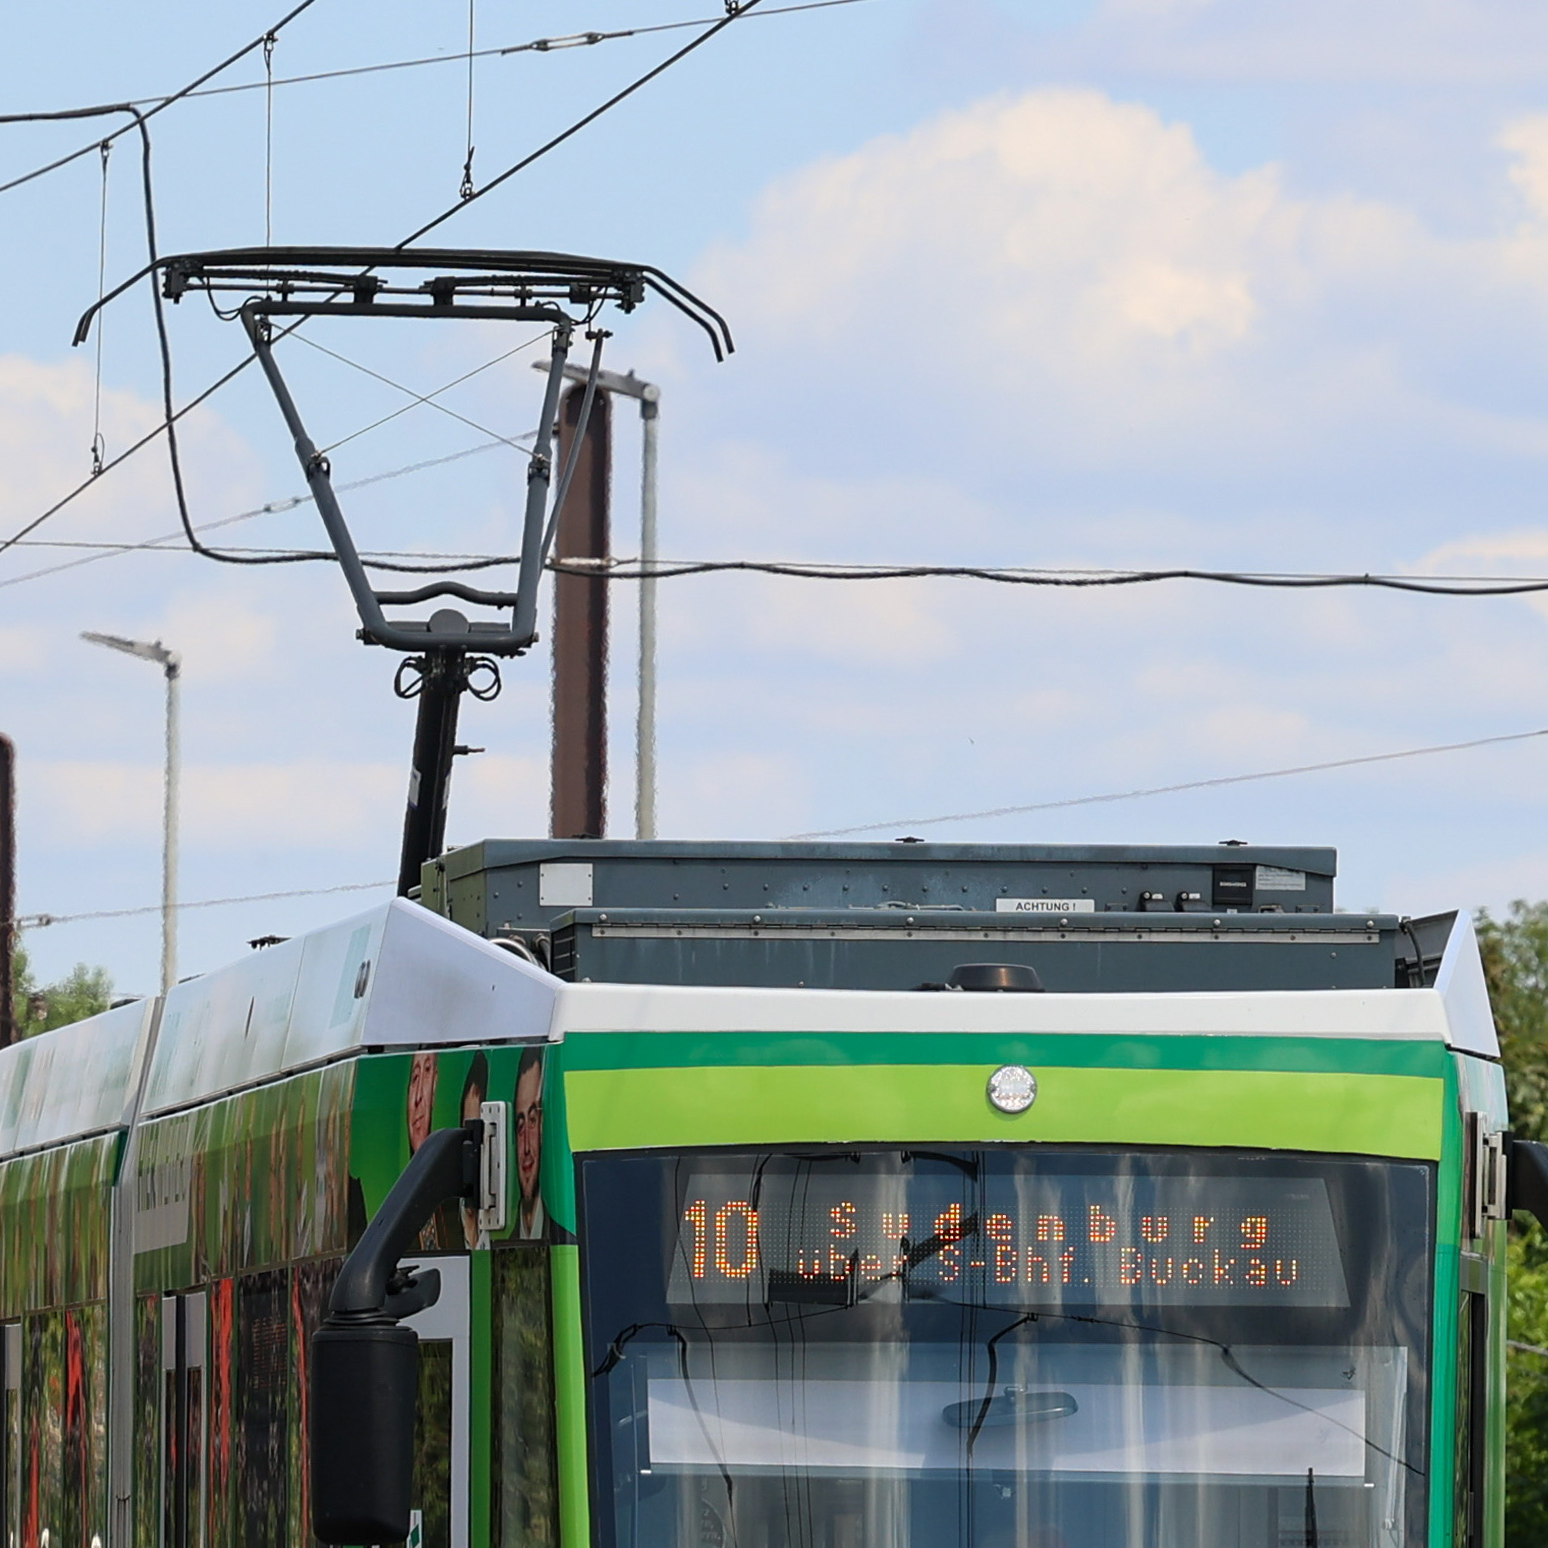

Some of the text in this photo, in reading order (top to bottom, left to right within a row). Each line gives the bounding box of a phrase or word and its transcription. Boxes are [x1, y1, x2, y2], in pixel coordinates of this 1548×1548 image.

[1015, 902, 1069, 912] ACHTUNG
[685, 1200, 758, 1278] 10
[829, 1202, 1269, 1249] Sudenburg
[797, 1244, 1298, 1286] über S-Bhf. Buckau
